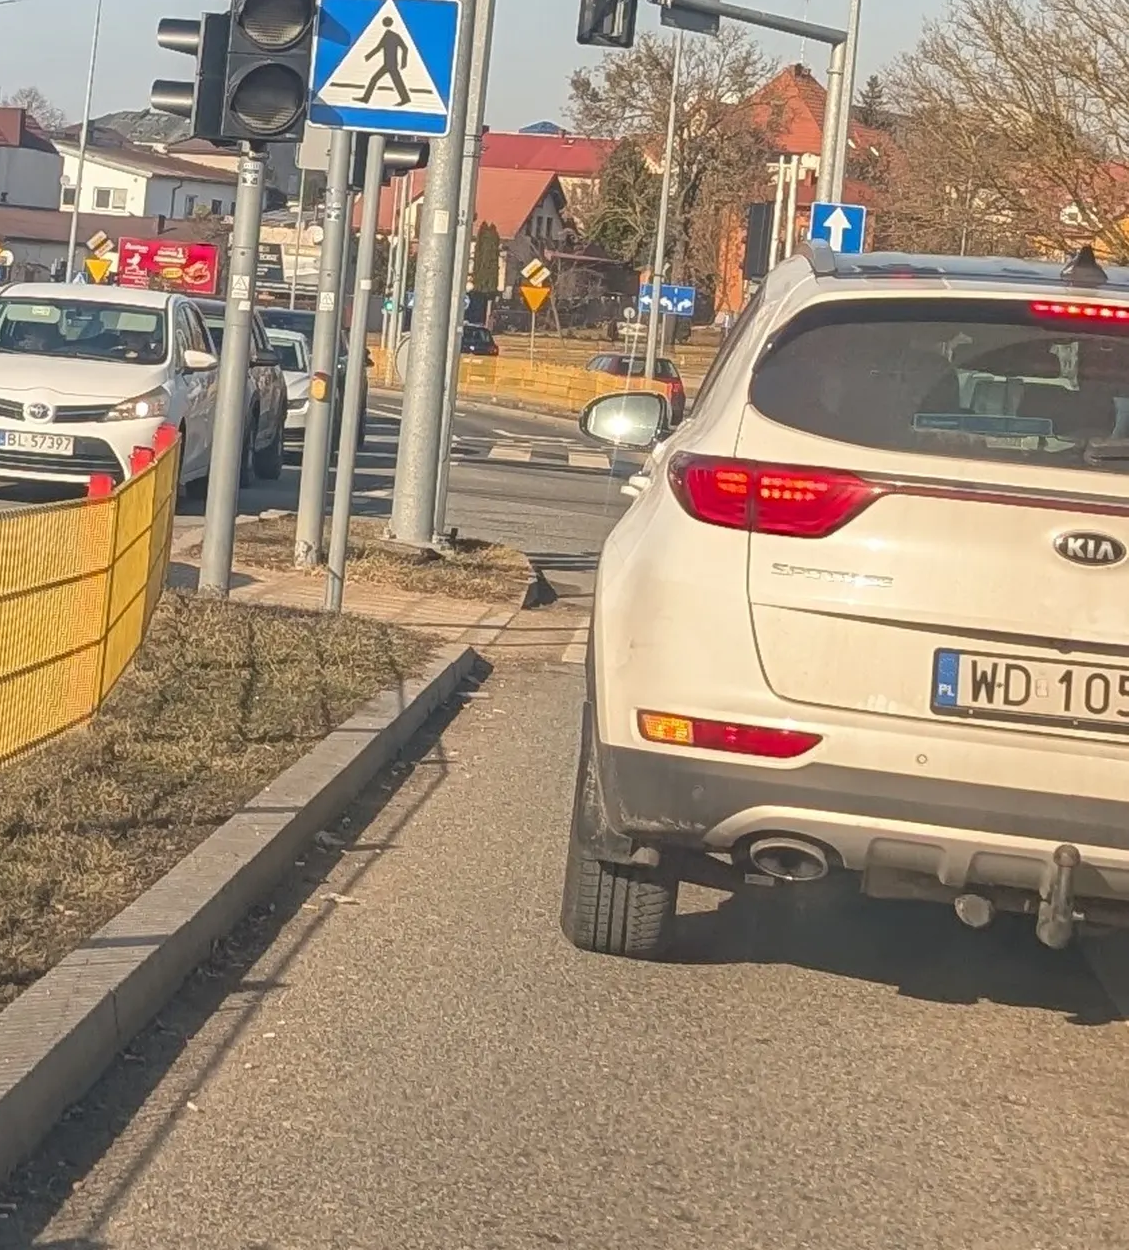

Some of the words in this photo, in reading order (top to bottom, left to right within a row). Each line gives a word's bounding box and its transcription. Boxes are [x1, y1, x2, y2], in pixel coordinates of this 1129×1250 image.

[7, 433, 26, 447] BL
[30, 434, 71, 451] 57397
[1066, 536, 1115, 560] KIA
[938, 683, 955, 698] PL
[971, 659, 1032, 707] WD
